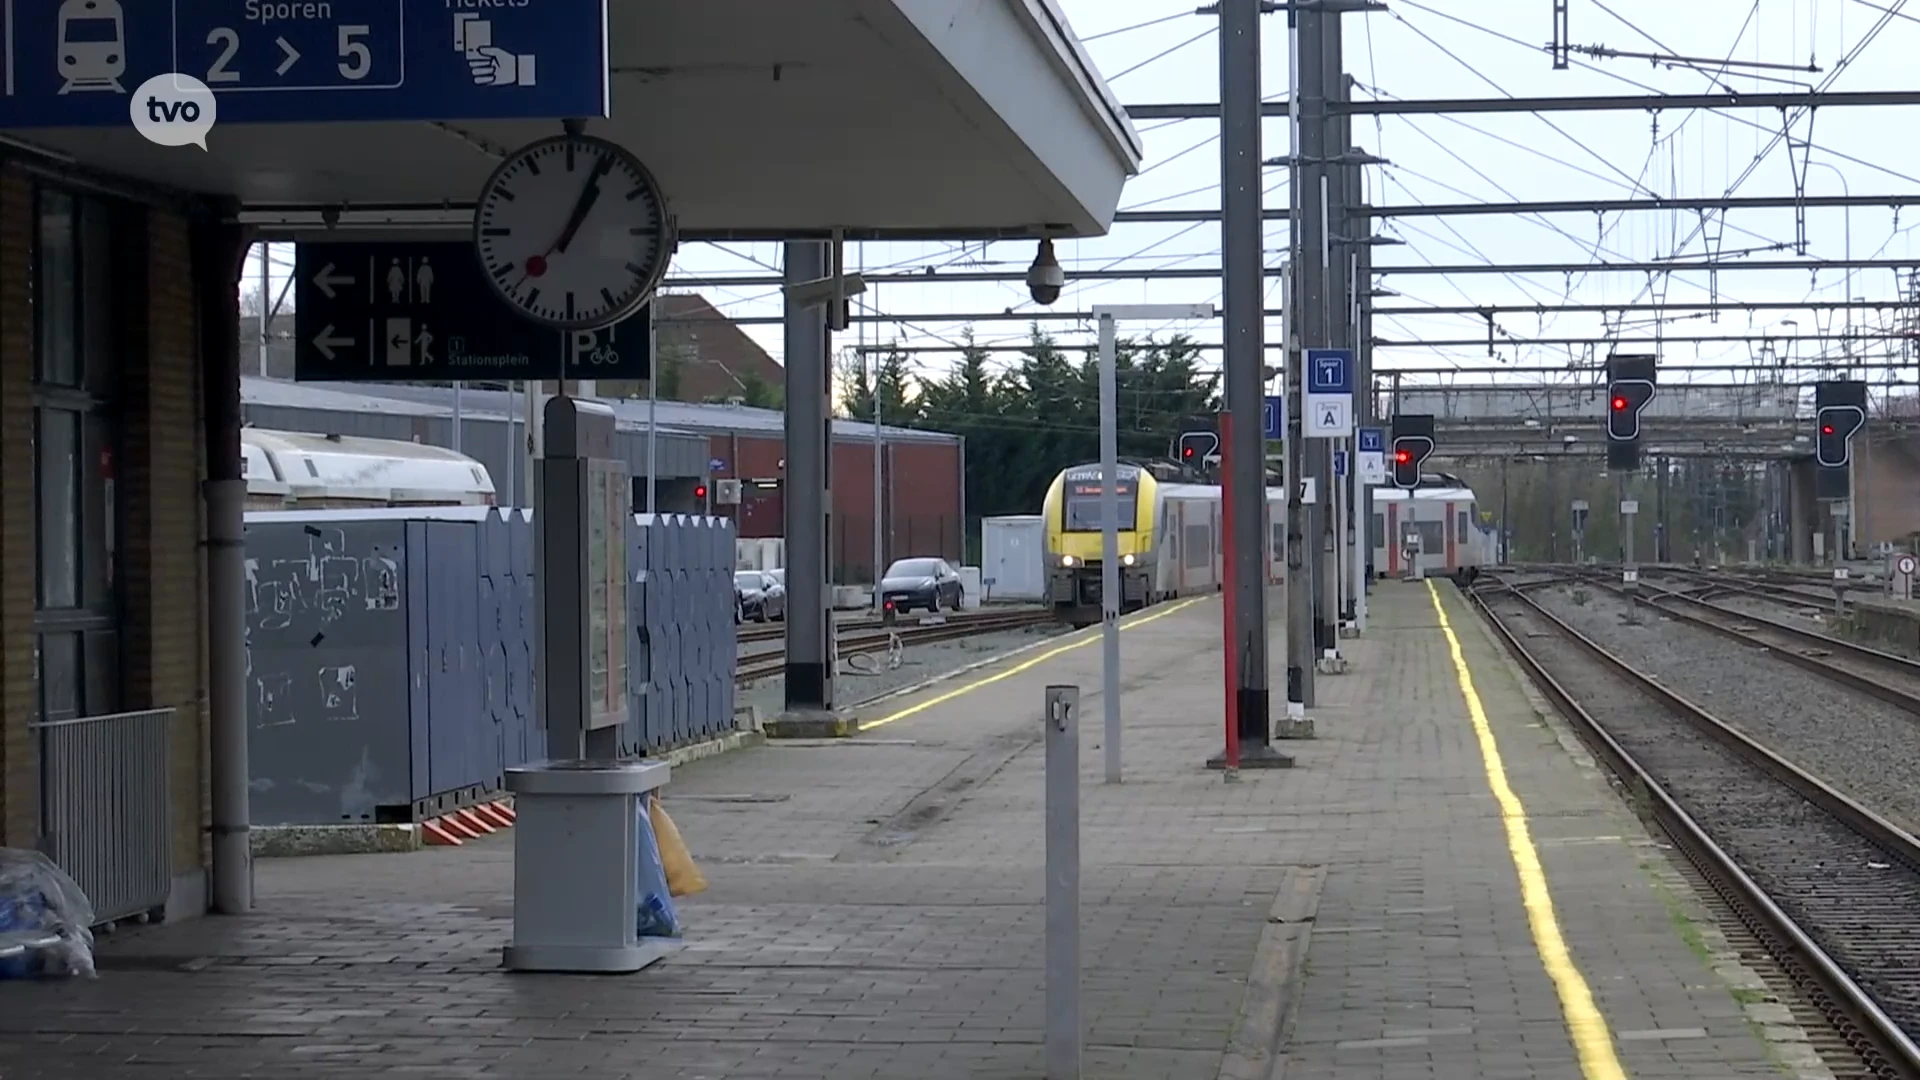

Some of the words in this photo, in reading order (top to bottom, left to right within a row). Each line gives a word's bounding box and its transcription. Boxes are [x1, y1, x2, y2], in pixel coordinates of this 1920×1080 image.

[245, 0, 332, 25] Sporen
[206, 27, 241, 83] 2
[337, 25, 372, 80] 5
[571, 330, 598, 365] P
[448, 354, 530, 368] Stationsplein
[1325, 368, 1333, 384] 1
[1323, 411, 1336, 425] A
